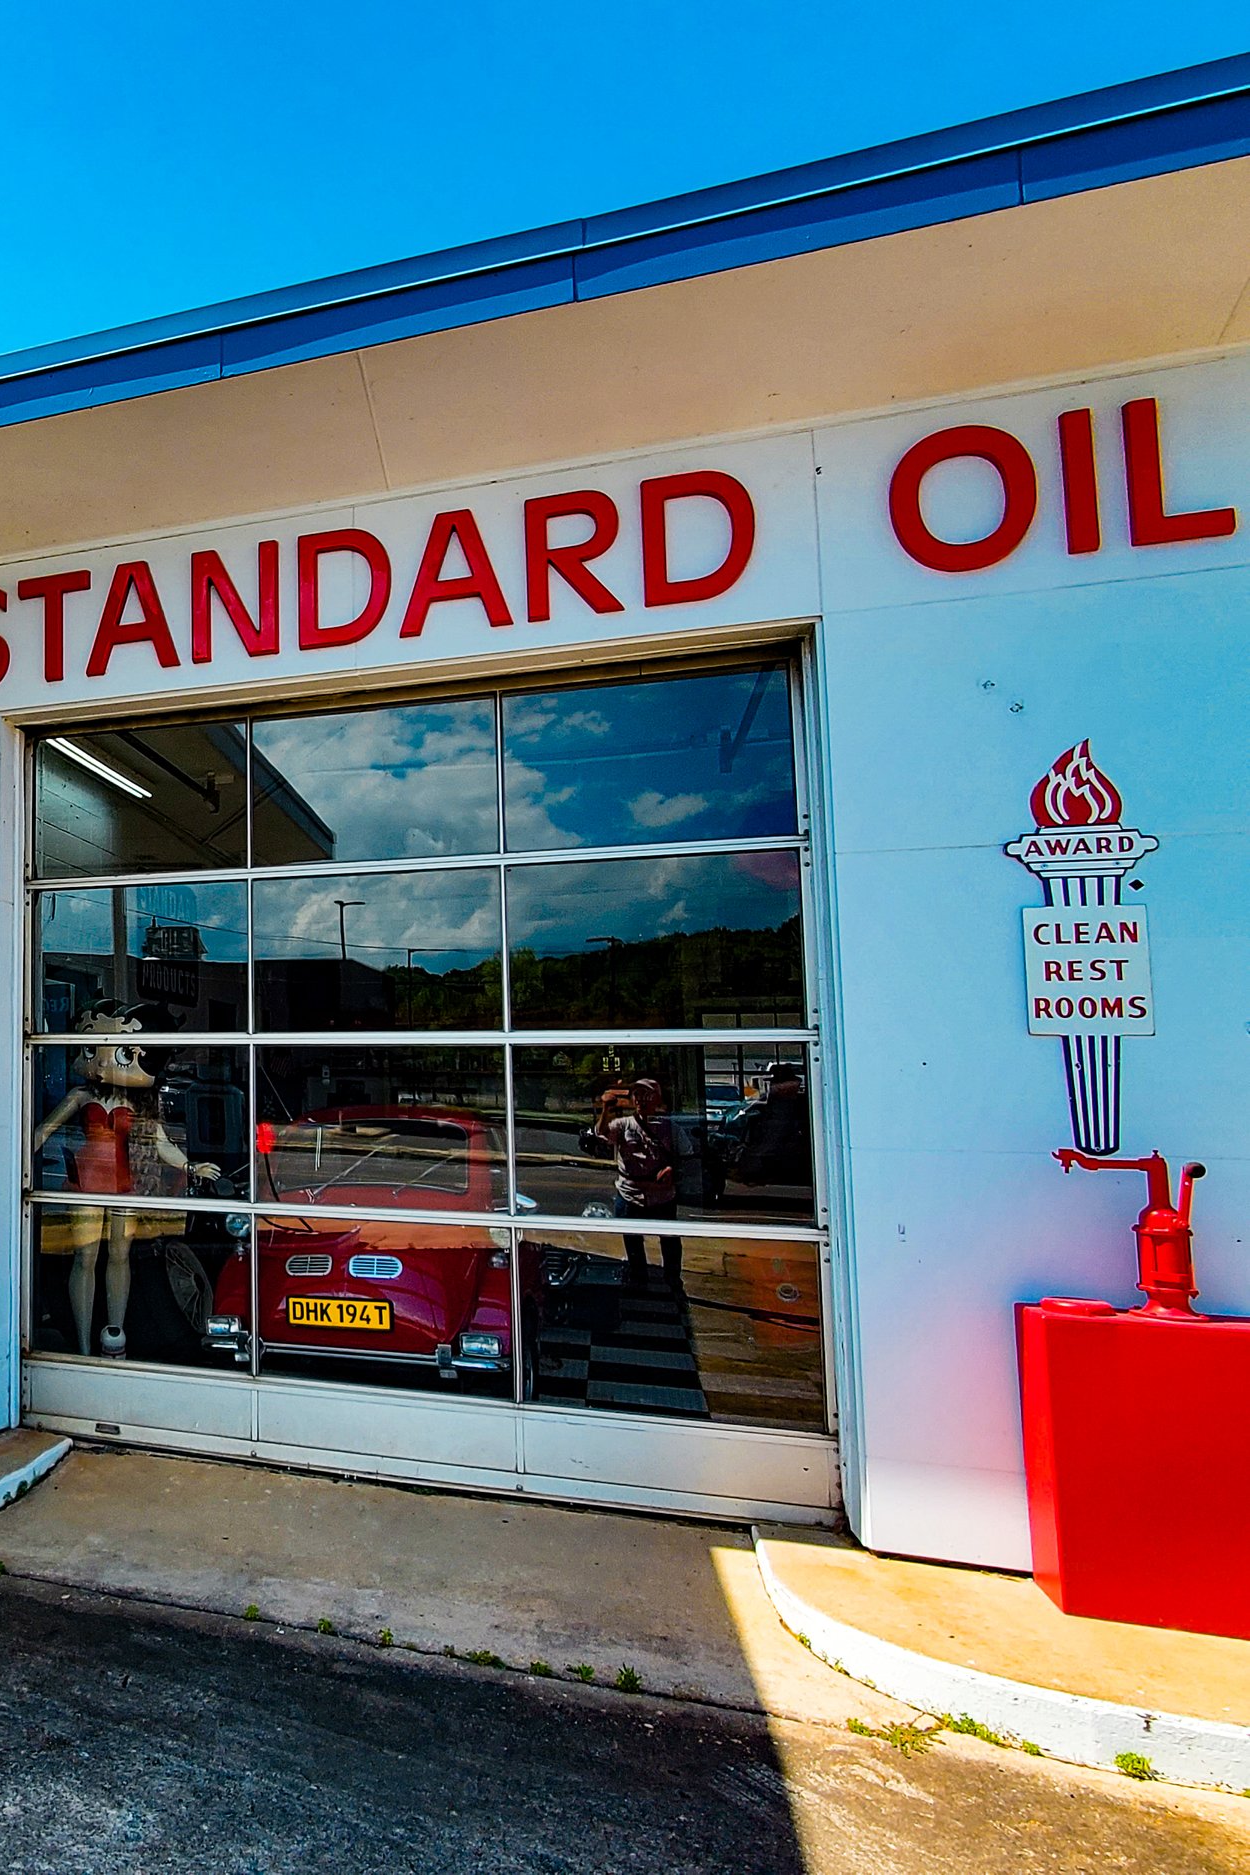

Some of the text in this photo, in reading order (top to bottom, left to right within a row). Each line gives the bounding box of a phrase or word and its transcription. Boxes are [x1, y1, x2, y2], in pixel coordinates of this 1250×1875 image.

[888, 397, 1238, 574] OIL
[1023, 835, 1135, 858] AWARD
[1033, 921, 1139, 945] CLEAN
[141, 961, 197, 997] PRODUCTS
[1044, 959, 1129, 982] REST
[1034, 996, 1147, 1019] ROOMS
[292, 1301, 332, 1323] DHK
